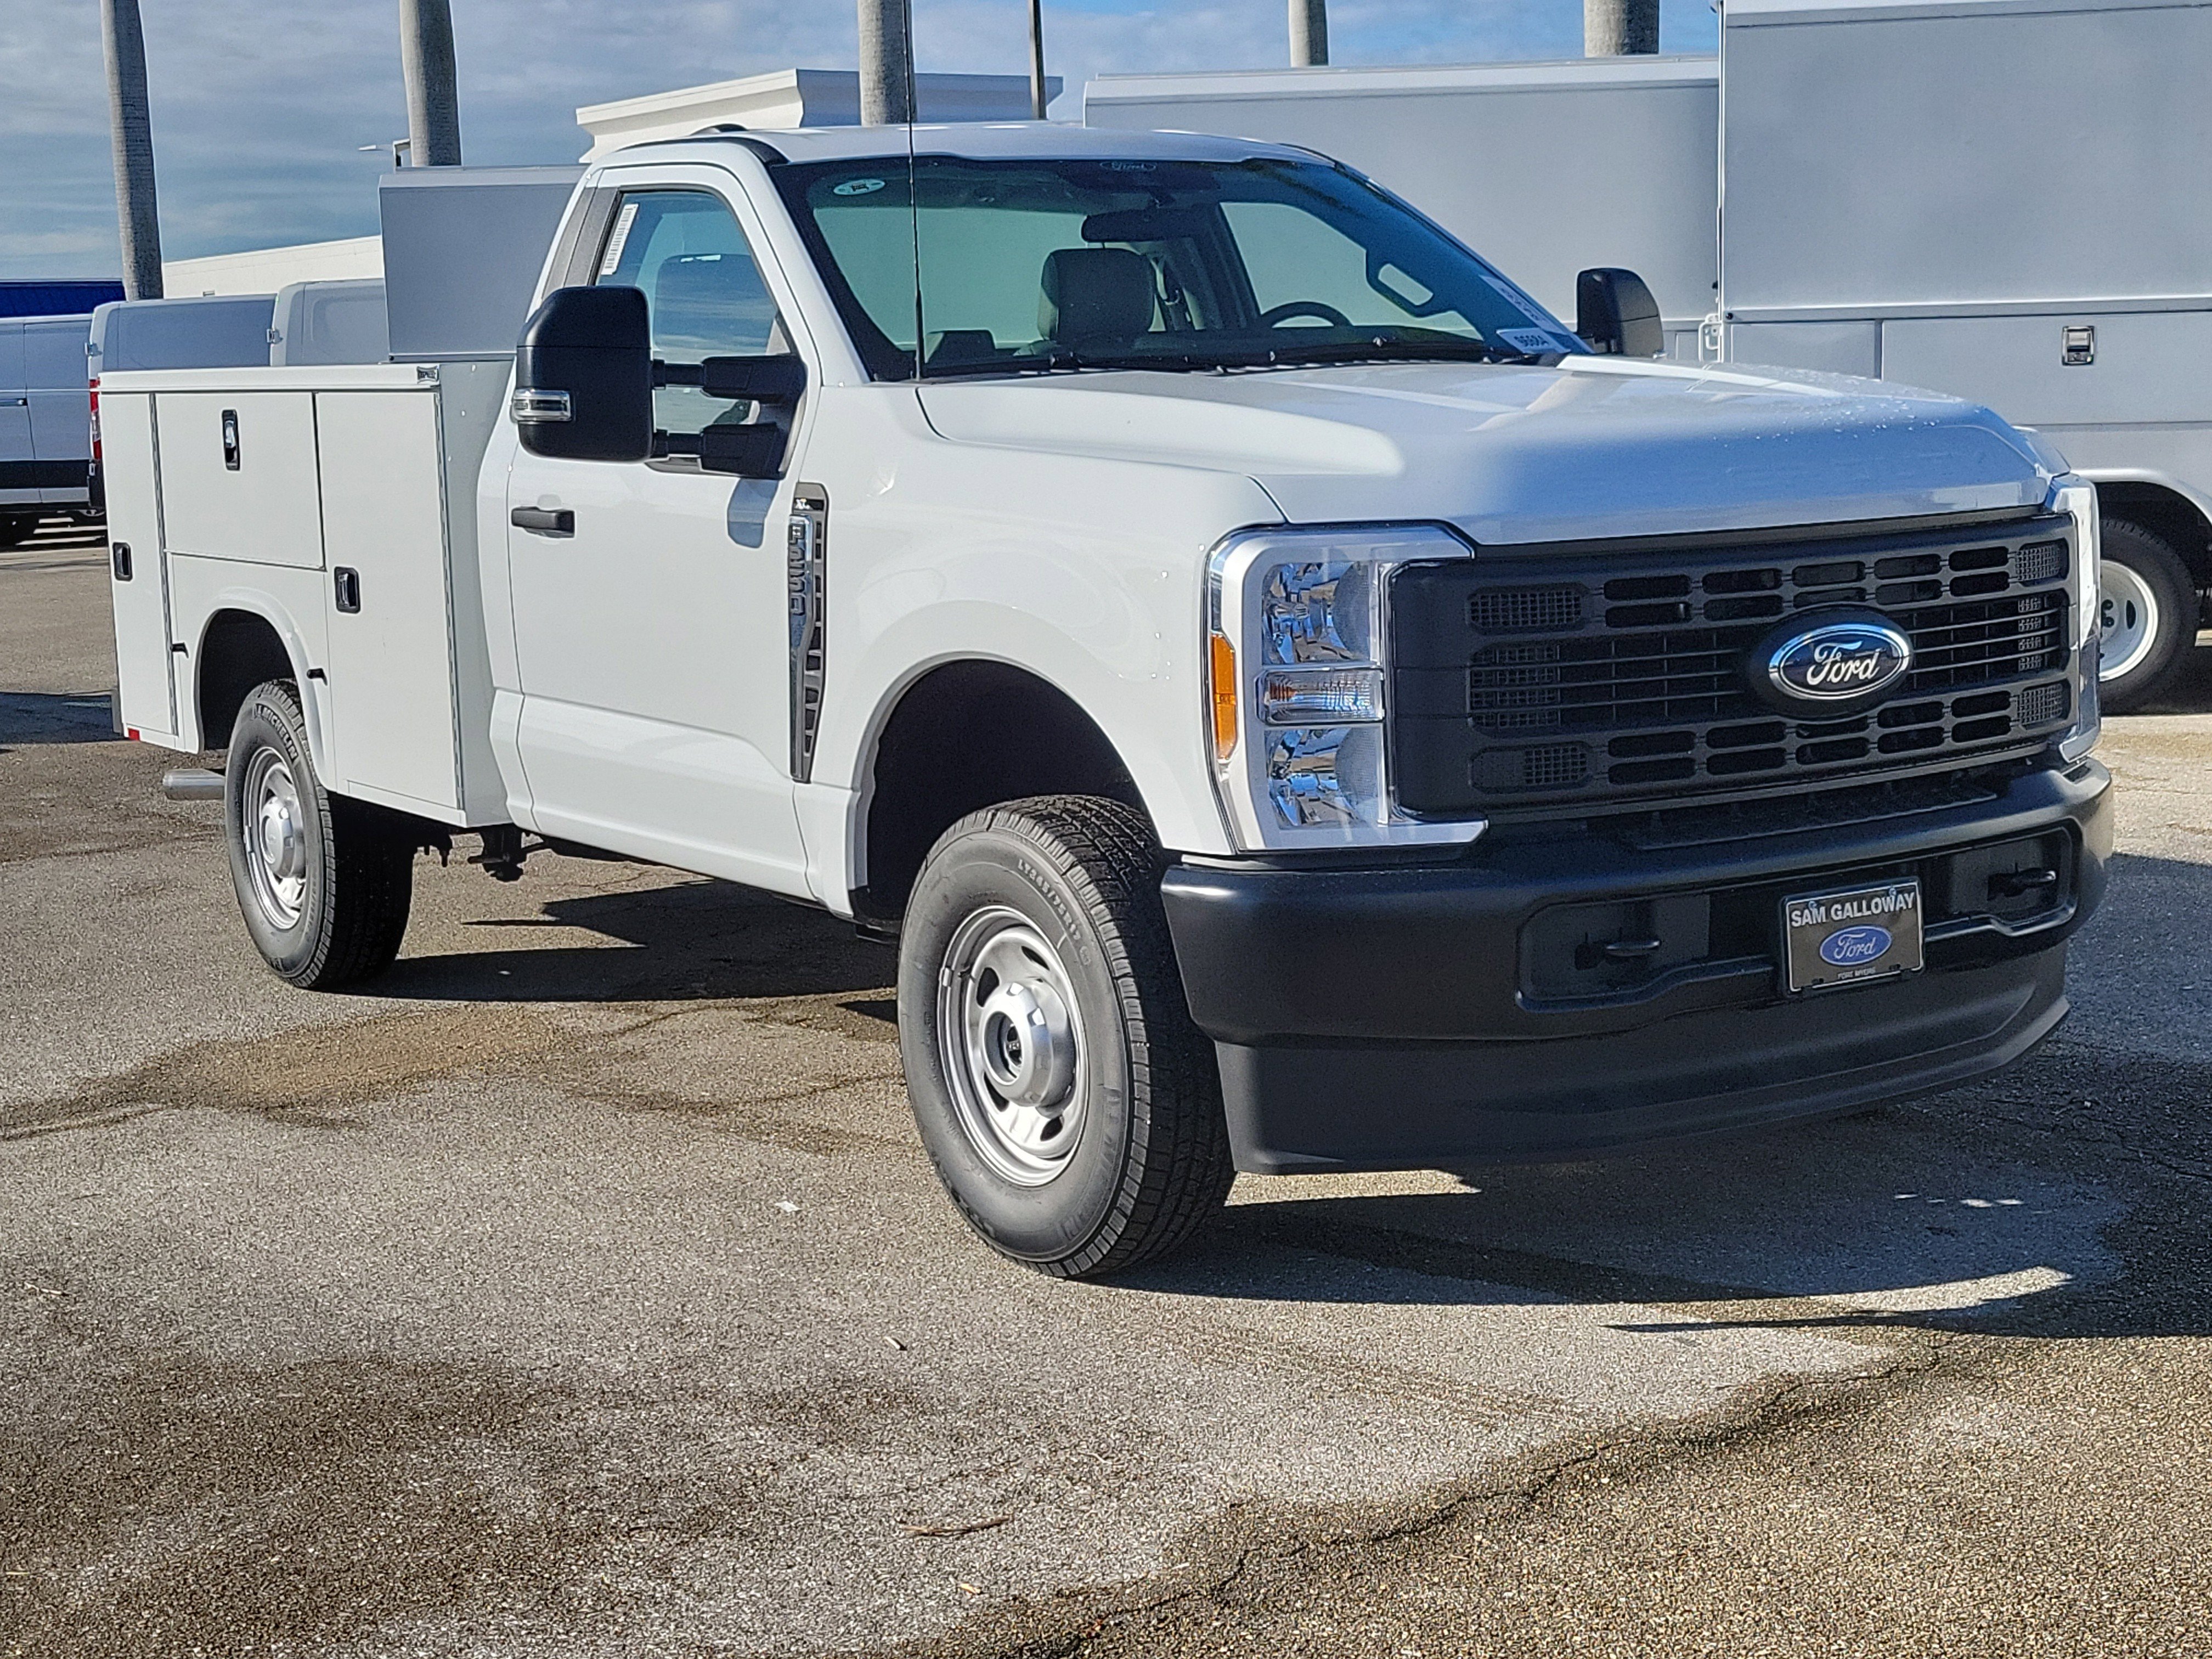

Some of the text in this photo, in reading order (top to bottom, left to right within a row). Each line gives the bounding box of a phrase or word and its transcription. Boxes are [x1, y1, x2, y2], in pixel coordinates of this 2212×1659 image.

[1806, 640, 1881, 686] Ford
[262, 706, 297, 759] MICHELIN
[1791, 892, 1915, 927] SAM GALLOWAY
[1833, 933, 1876, 960] Ford
